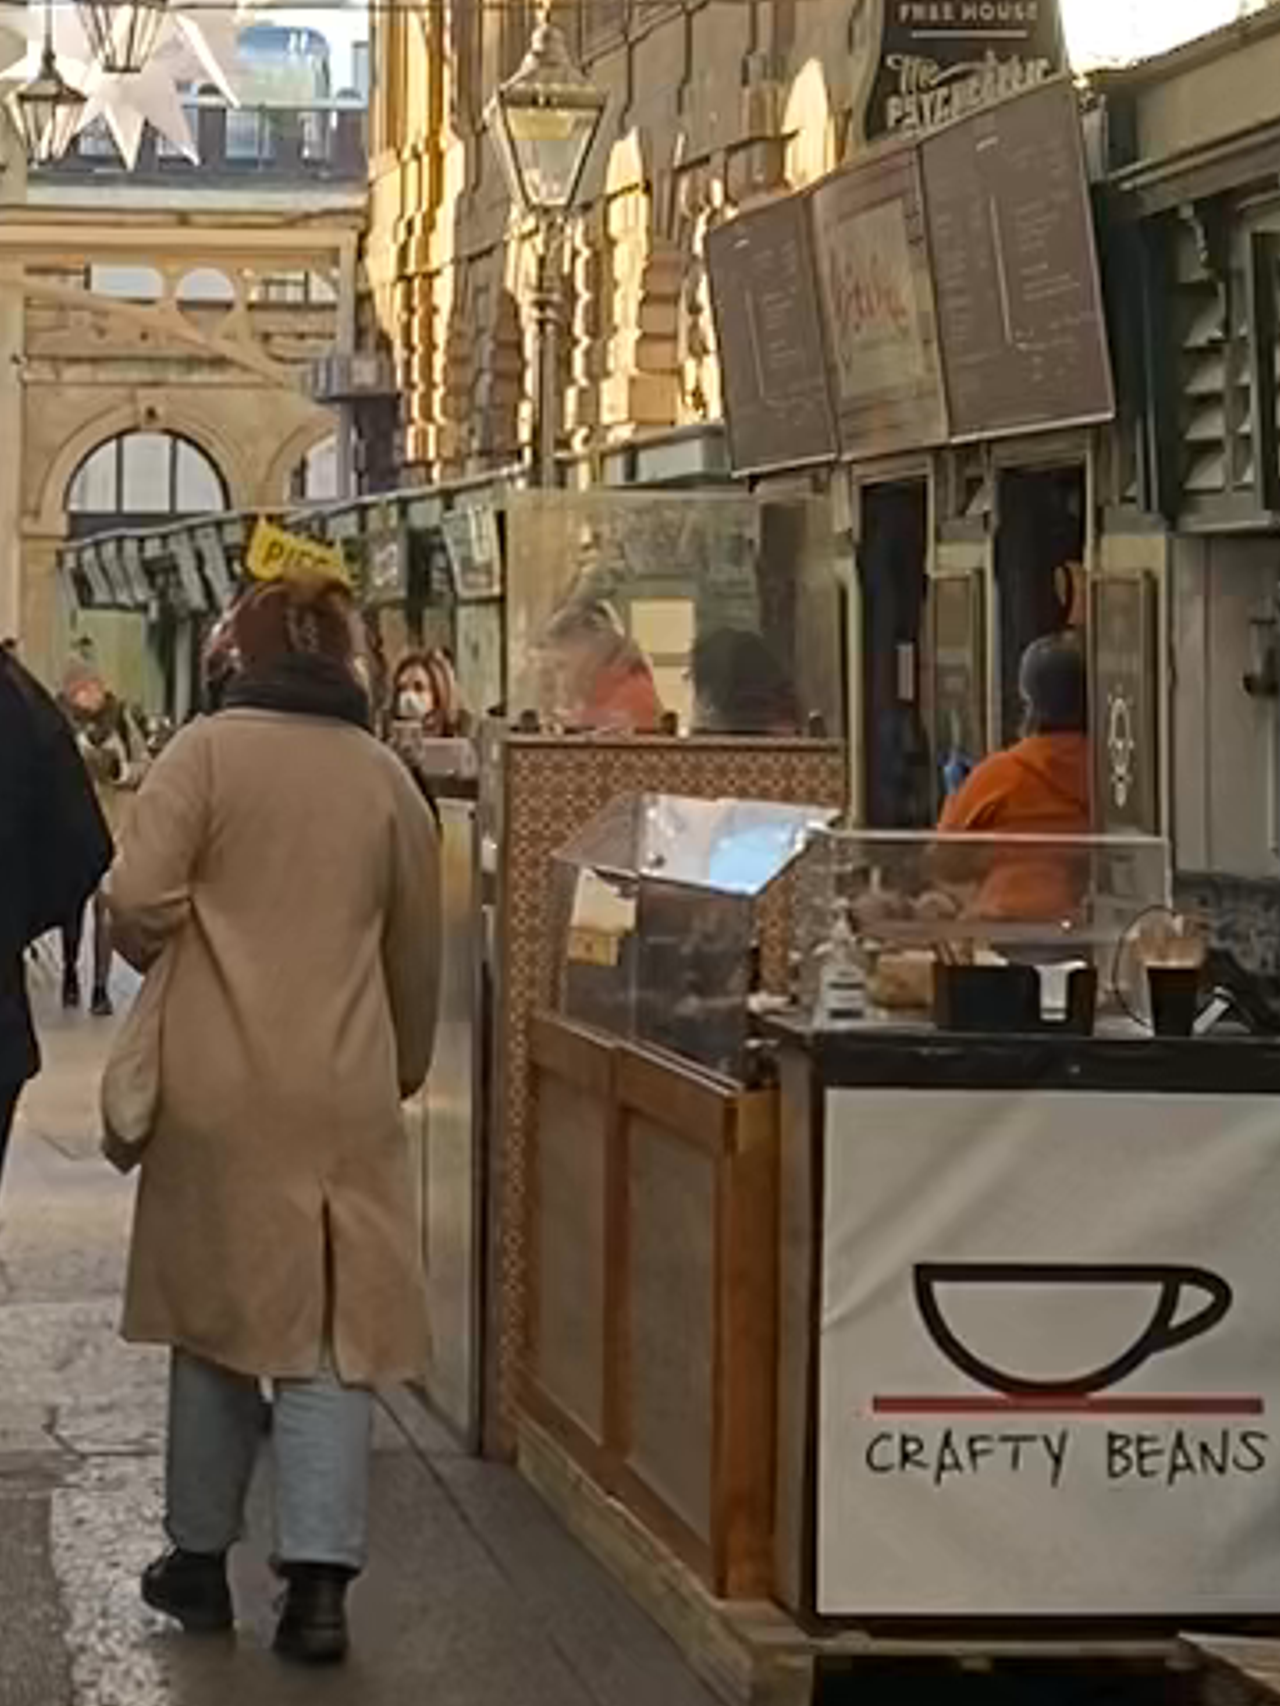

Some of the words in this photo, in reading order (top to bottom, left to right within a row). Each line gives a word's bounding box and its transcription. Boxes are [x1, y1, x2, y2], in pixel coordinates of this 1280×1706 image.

[898, 3, 955, 22] FREE
[960, 1, 1039, 22] HOUSE
[864, 1429, 1069, 1487] CRAFTY
[1106, 1429, 1270, 1486] BEANS
